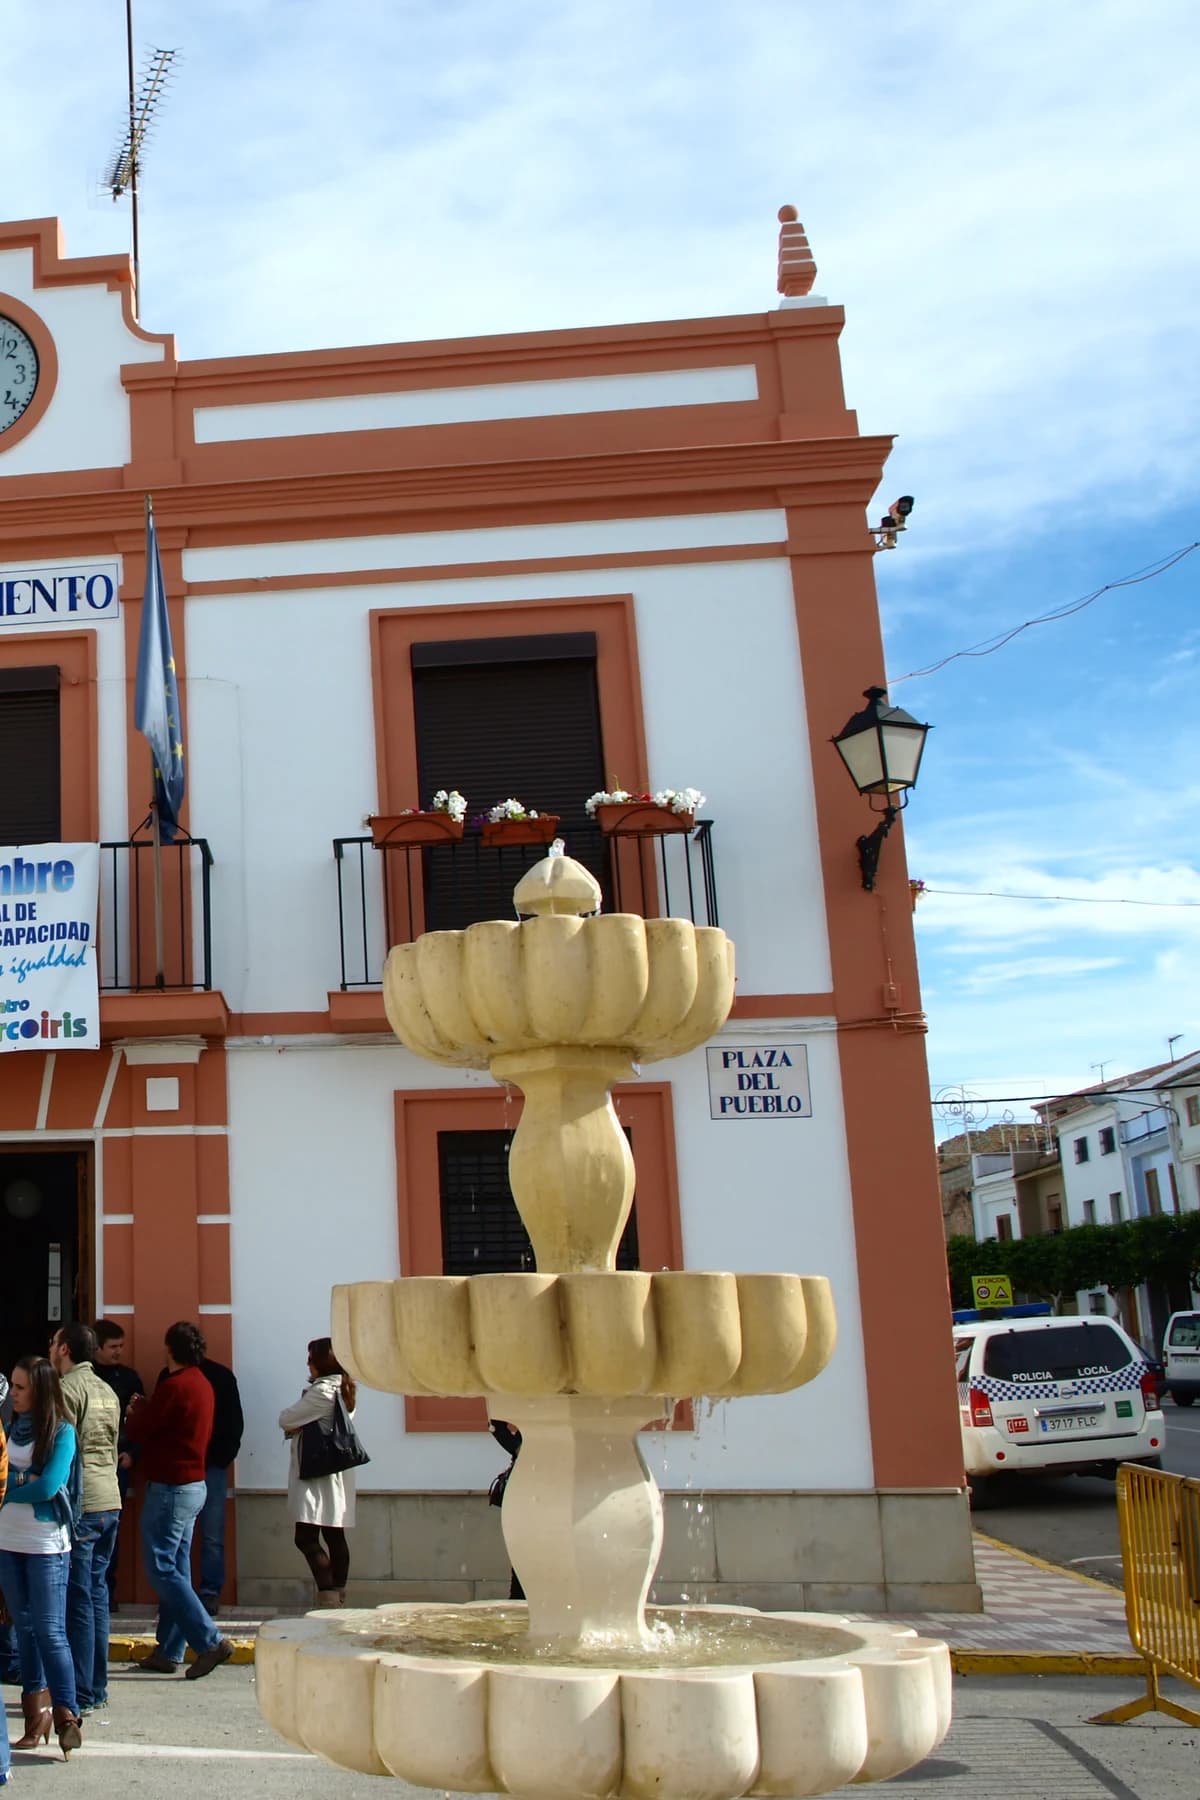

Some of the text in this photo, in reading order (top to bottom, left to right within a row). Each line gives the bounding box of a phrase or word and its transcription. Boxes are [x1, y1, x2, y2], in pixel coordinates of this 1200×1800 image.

[5, 339, 18, 360] 2
[13, 364, 26, 385] 3
[4, 390, 20, 410] 4
[15, 902, 37, 921] DE
[10, 944, 87, 983] igualdad
[722, 1050, 793, 1069] PLAZA
[737, 1072, 780, 1091] DEL
[720, 1095, 802, 1113] PUEBLO
[1012, 1365, 1112, 1382] POLICIA LOCAL
[1049, 1416, 1097, 1430] 3717 FLC
